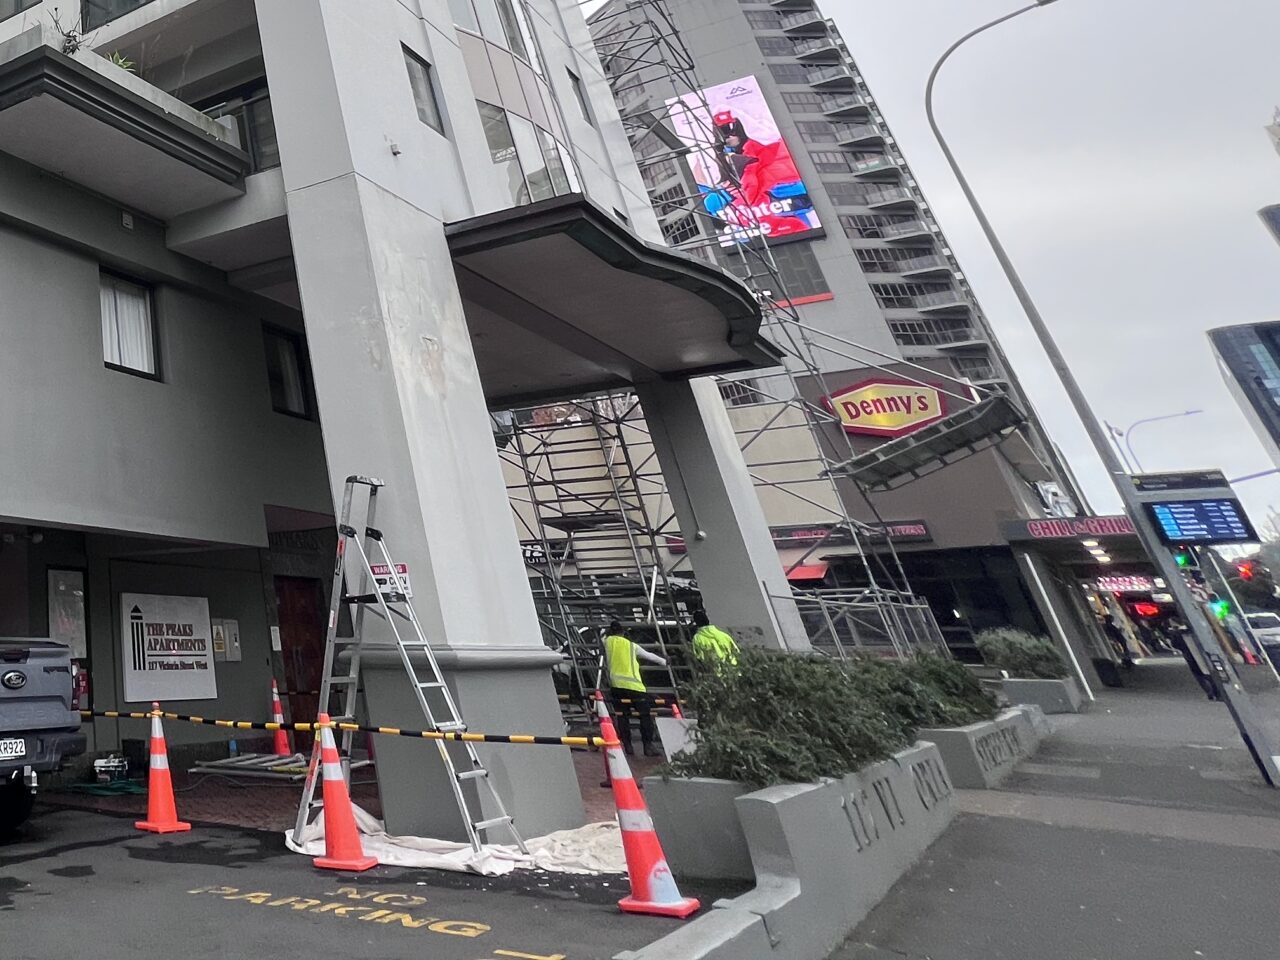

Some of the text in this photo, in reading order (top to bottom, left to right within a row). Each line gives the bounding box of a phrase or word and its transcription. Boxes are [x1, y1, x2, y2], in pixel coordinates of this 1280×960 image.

[1027, 519, 1077, 538] CHILL
[145, 623, 194, 636] THE PEAKS
[147, 638, 207, 651] APARTMENTS
[323, 886, 428, 906] NO
[187, 885, 491, 938] PARKING
